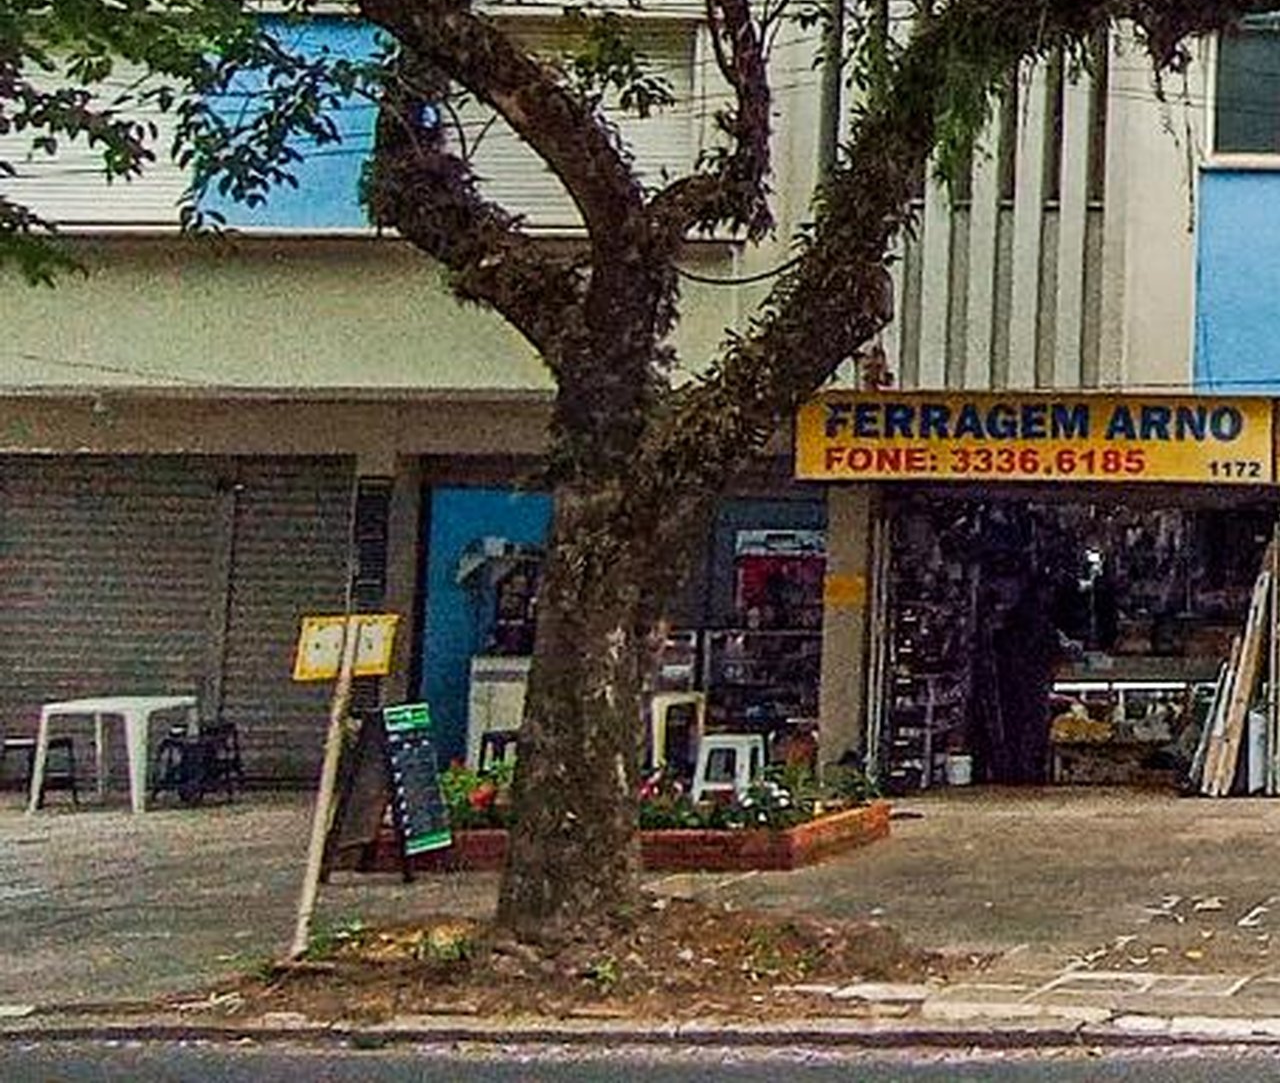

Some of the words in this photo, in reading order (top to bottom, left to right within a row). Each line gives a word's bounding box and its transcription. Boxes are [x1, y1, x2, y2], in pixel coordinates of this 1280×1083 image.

[824, 403, 1089, 440] FERRAGEM
[1103, 405, 1244, 442] ARNO
[824, 447, 938, 473] FONE:
[950, 448, 1146, 474] 3336.6185
[1208, 461, 1261, 477] 1172
